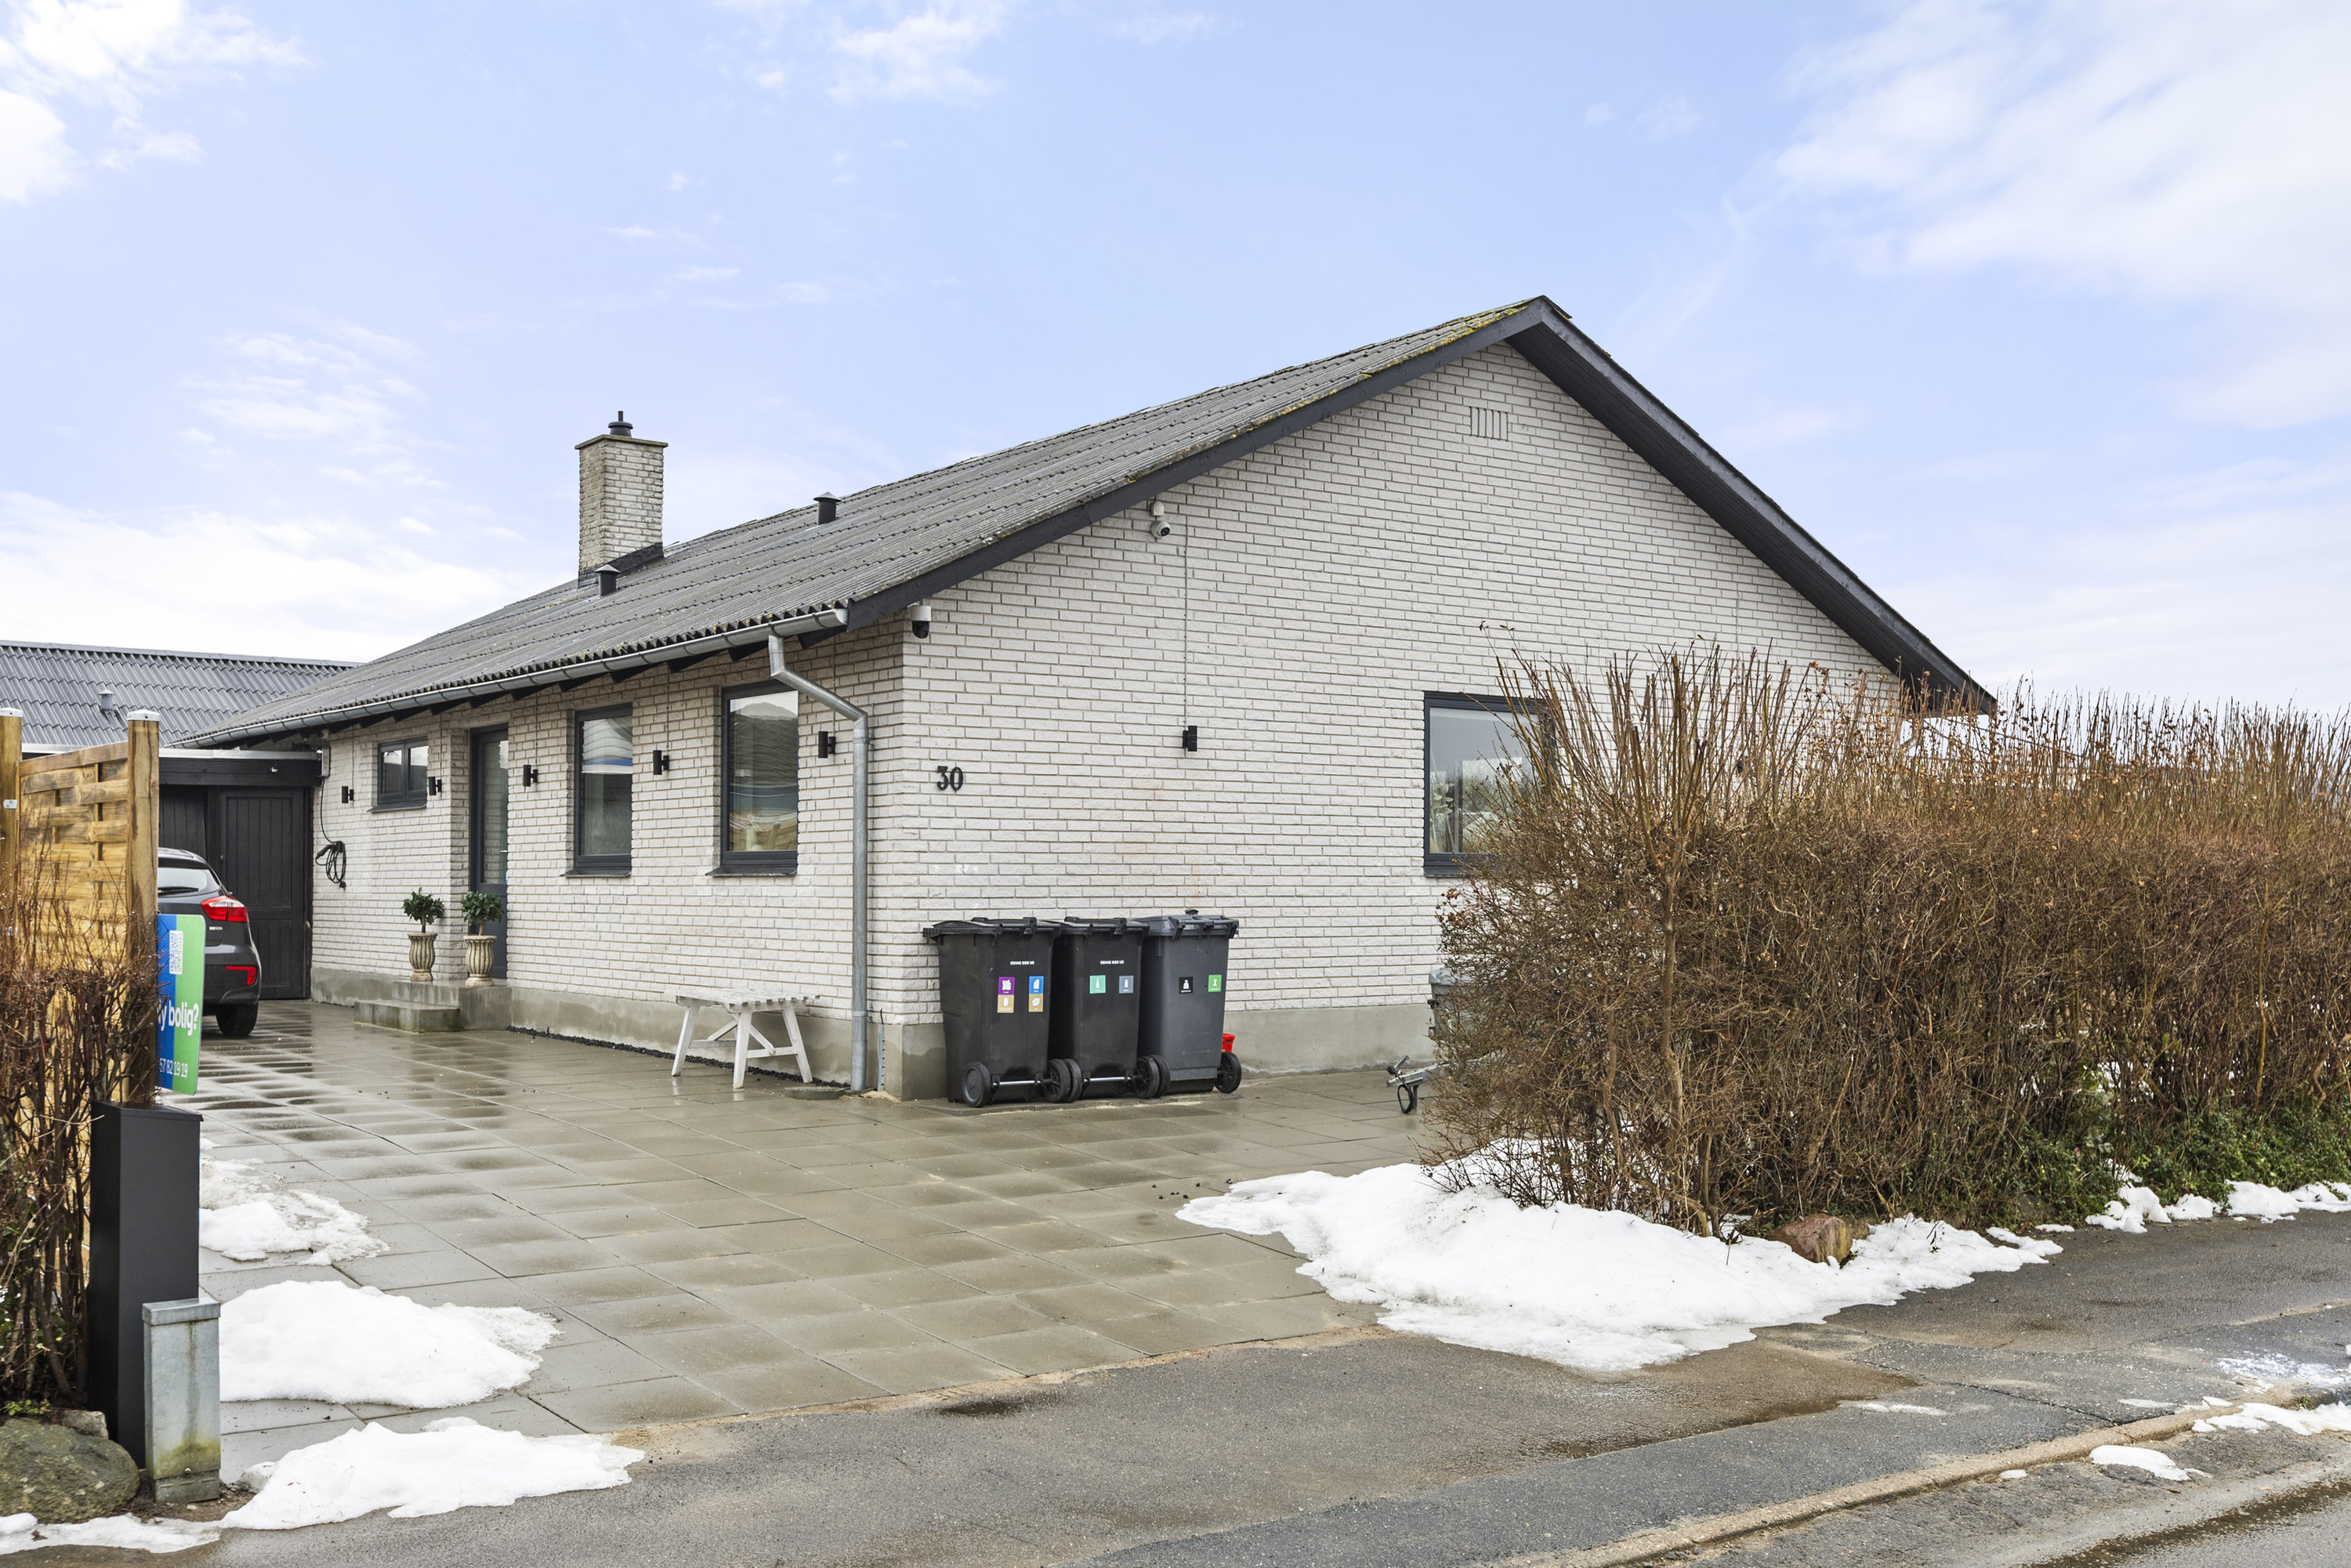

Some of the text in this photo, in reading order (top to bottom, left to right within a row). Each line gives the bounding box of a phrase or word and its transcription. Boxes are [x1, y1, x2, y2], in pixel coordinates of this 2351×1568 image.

[937, 766, 963, 791] 30
[168, 1000, 199, 1037] bolig?
[159, 1058, 188, 1078] 57 82 19 19
